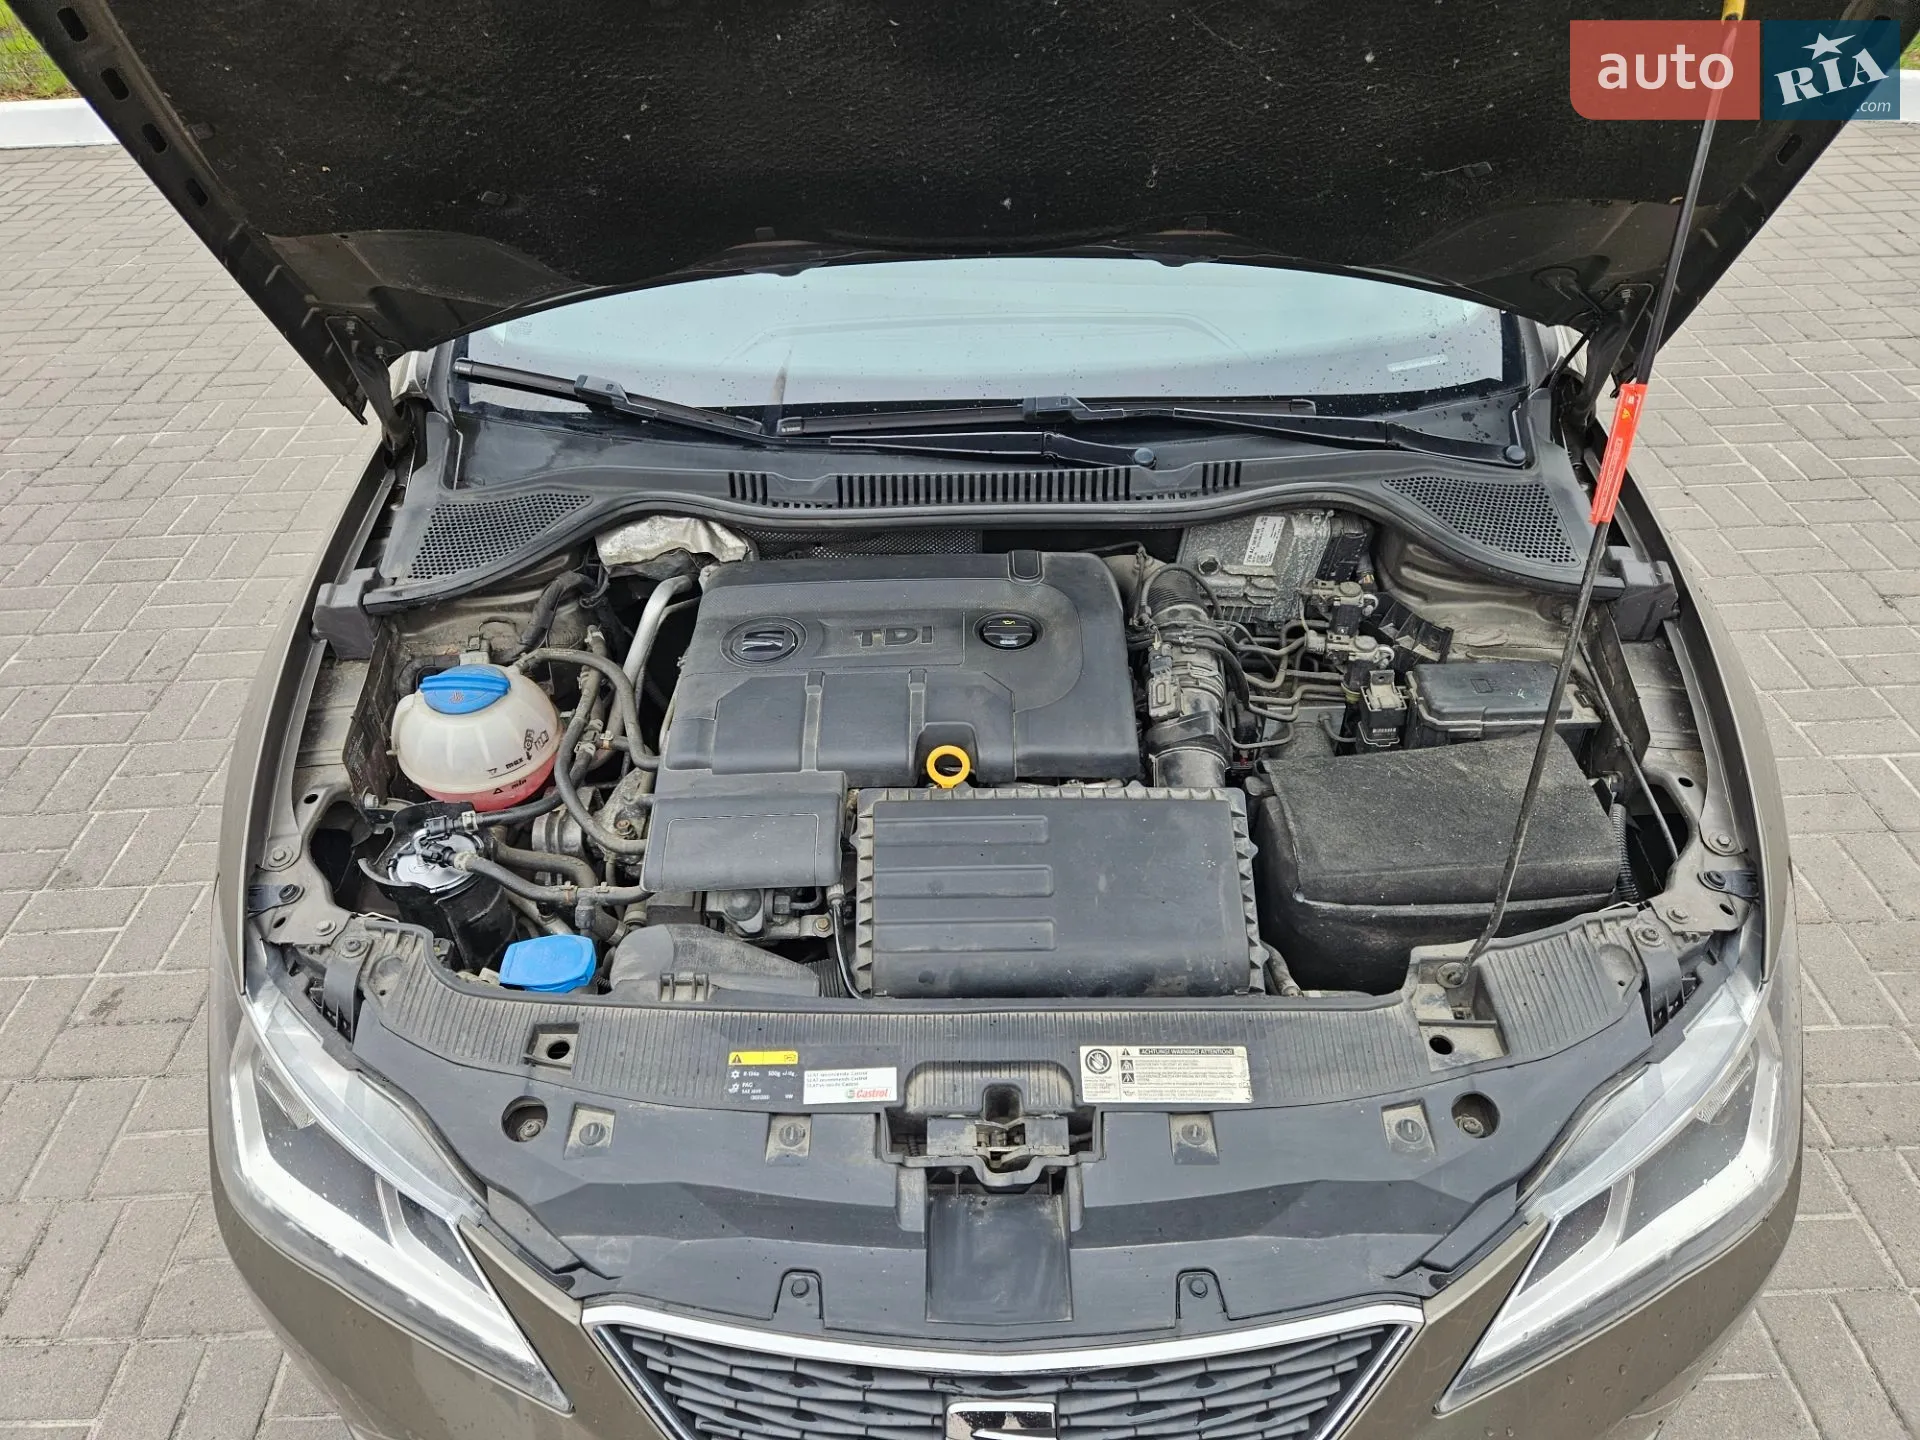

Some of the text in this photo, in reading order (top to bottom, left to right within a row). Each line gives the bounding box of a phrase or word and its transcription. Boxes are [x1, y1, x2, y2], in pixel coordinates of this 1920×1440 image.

[853, 625, 935, 647] TDI
[505, 757, 524, 769] max
[511, 779, 527, 789] min
[855, 1088, 889, 1099] Castrol
